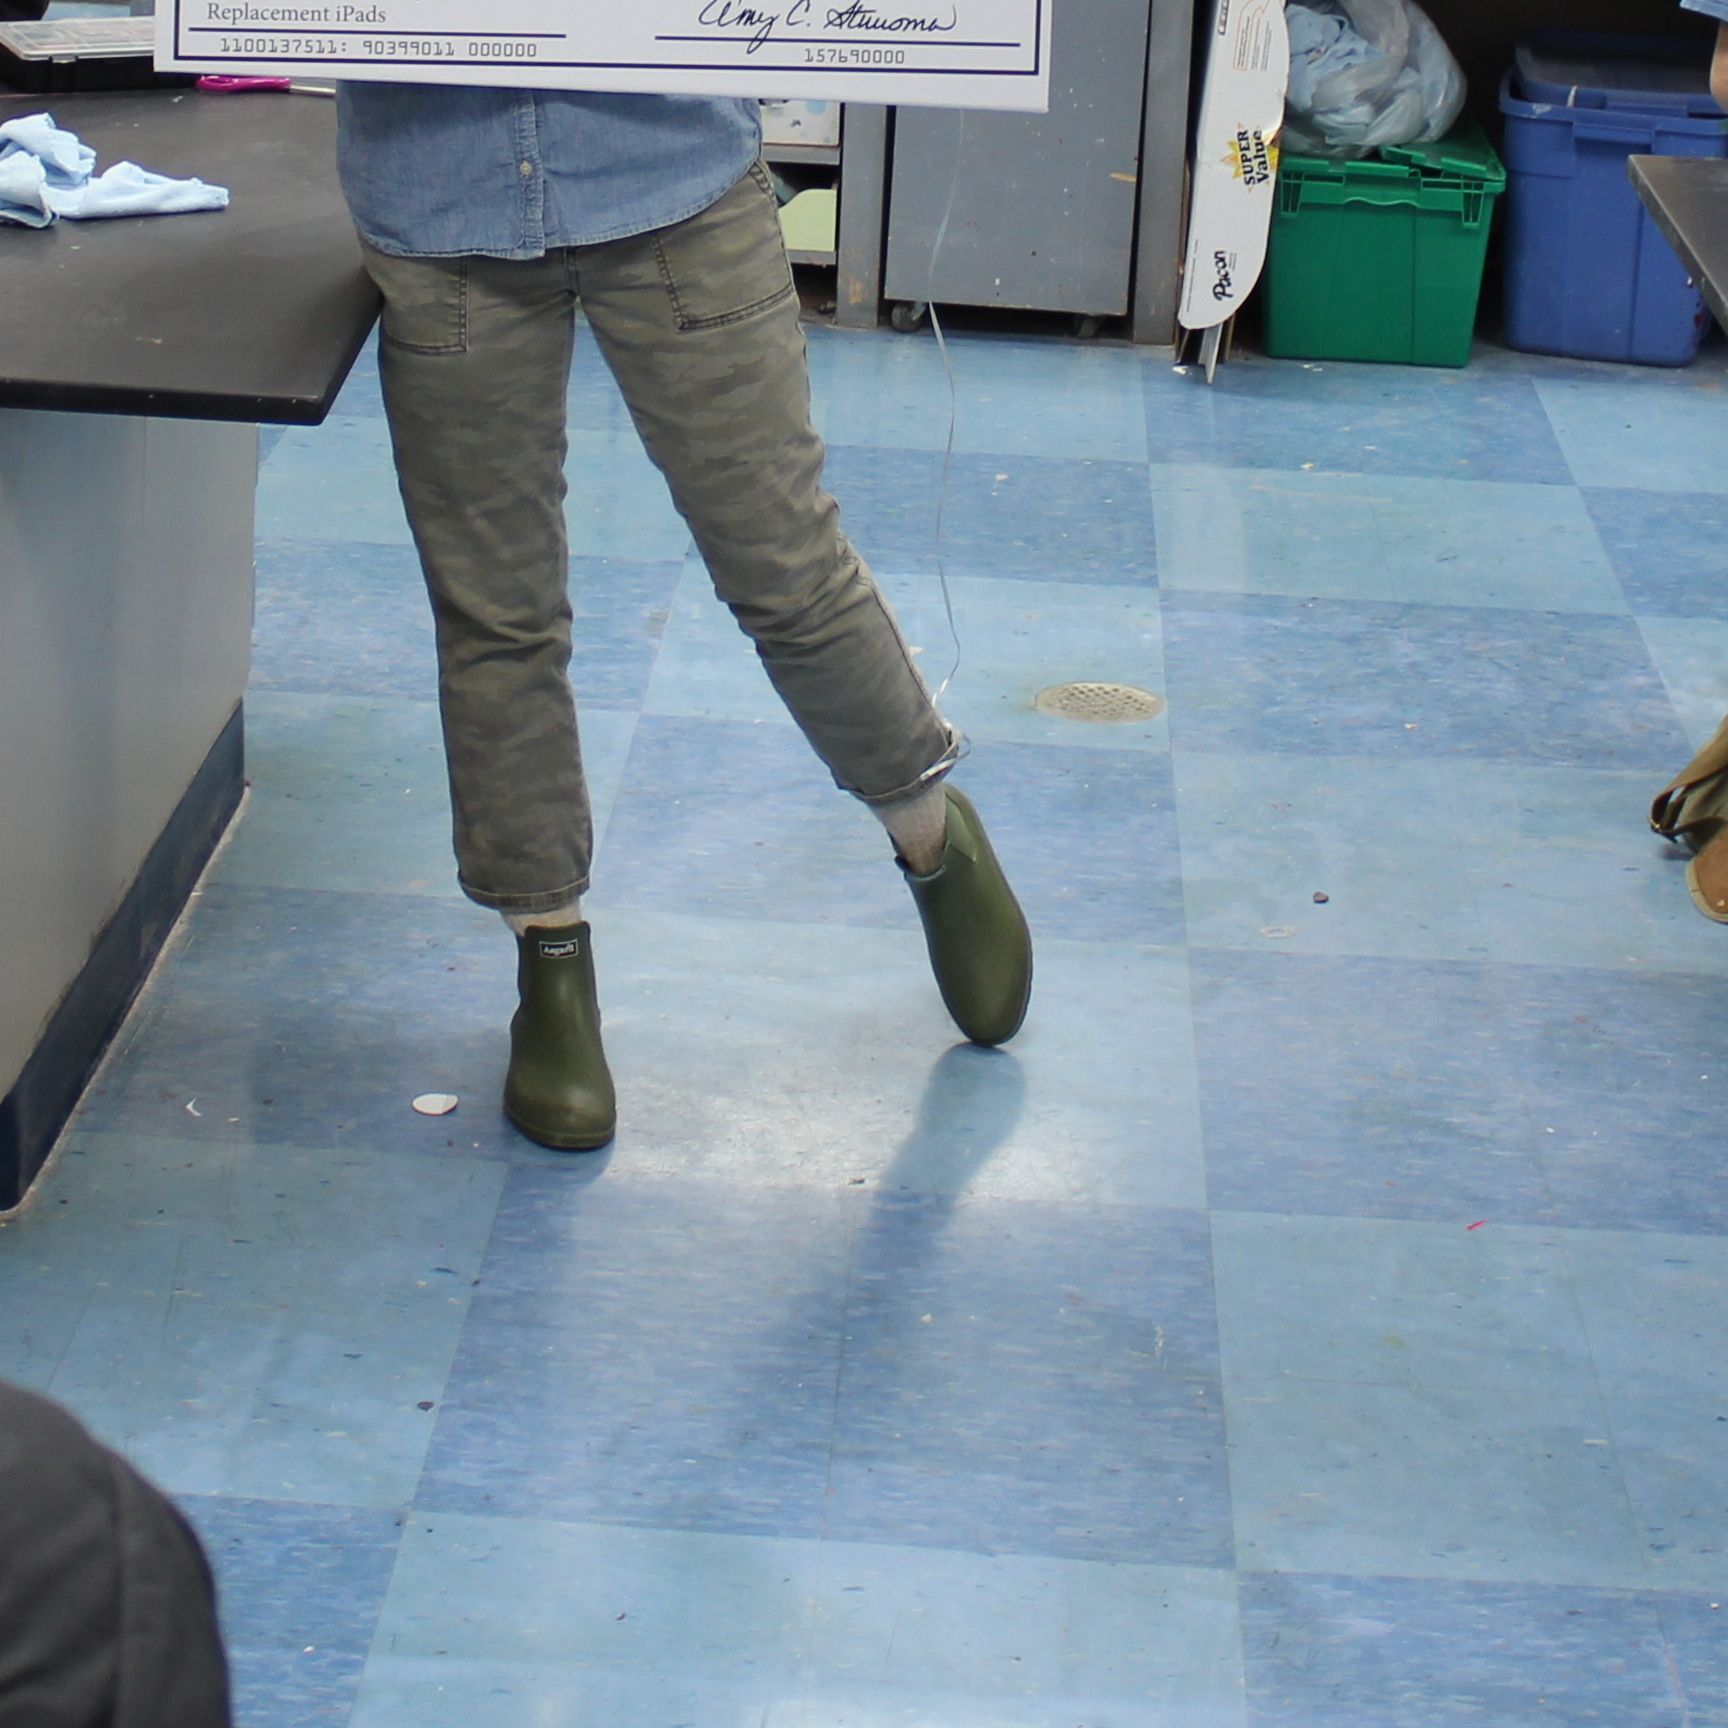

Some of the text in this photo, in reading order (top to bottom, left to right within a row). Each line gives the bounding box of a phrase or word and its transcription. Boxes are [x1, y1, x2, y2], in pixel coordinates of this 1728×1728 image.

[207, 2, 387, 25] Replacement iPads
[1236, 129, 1257, 186] SUPER
[1253, 129, 1270, 184] Value
[1212, 250, 1234, 302] Pacon
